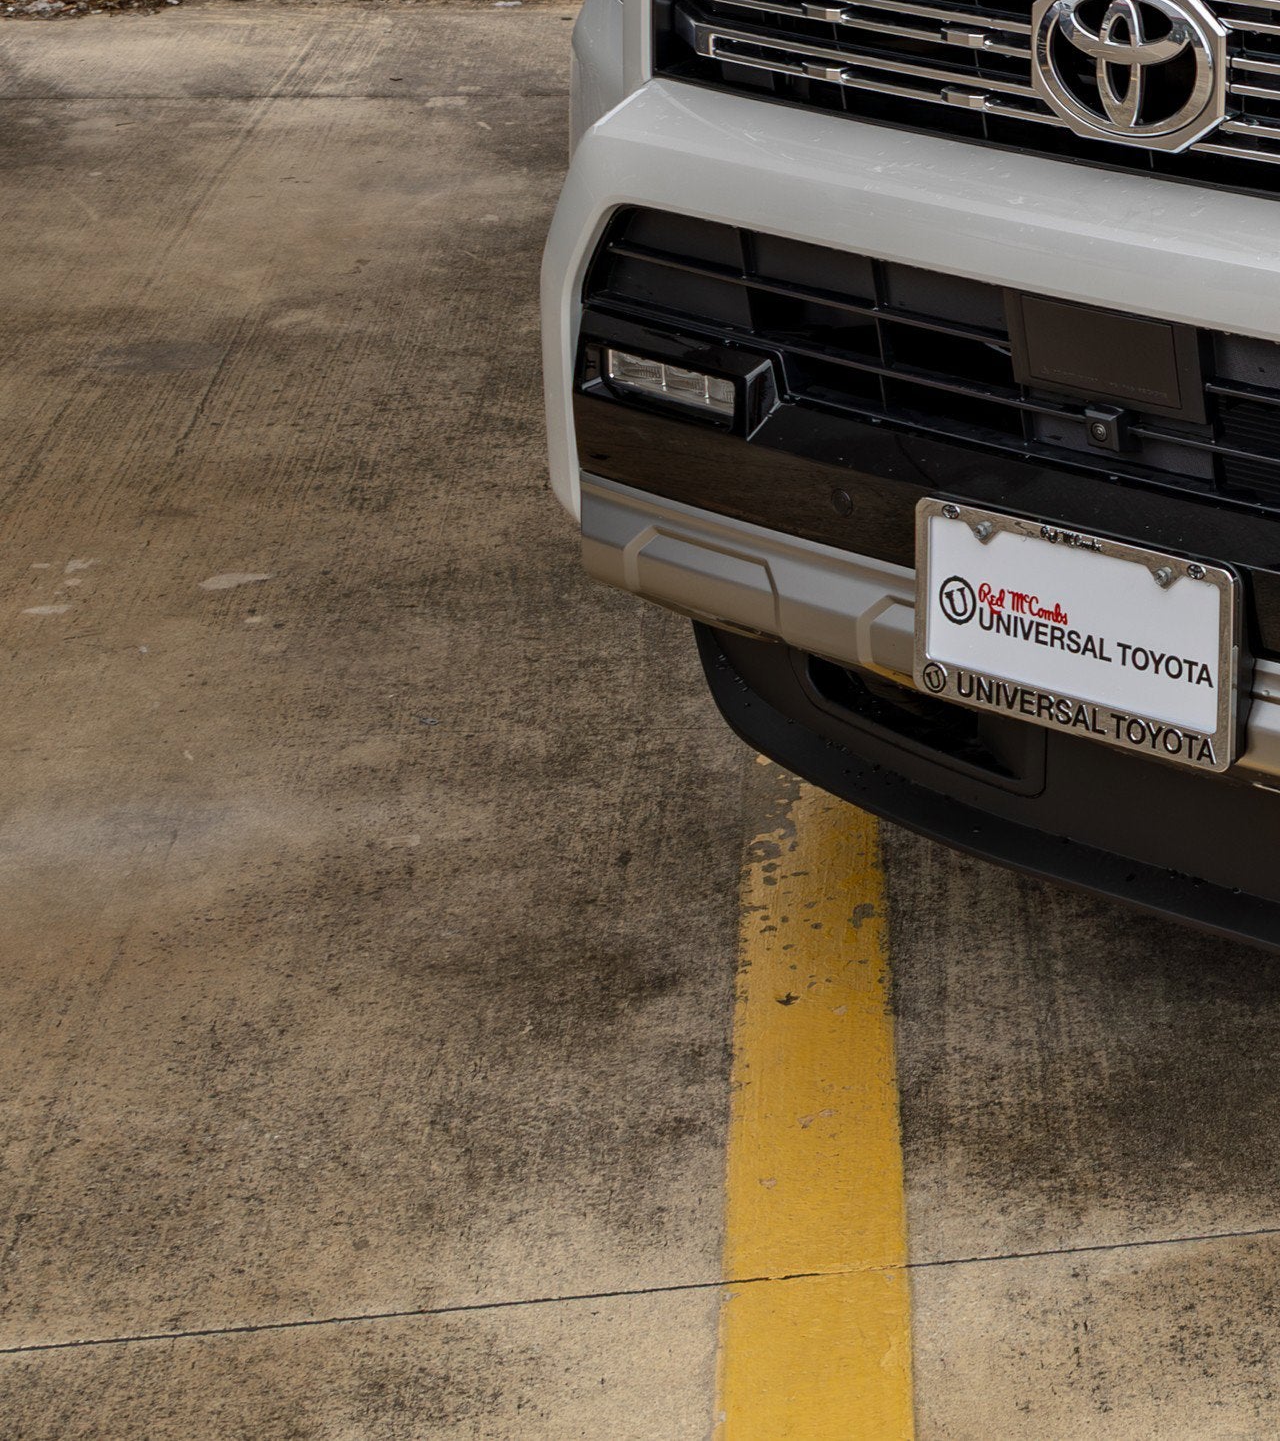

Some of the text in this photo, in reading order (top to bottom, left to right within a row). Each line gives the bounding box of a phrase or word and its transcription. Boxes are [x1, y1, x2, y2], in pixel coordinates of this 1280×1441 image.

[978, 582, 1069, 626] Red McCombs
[978, 607, 1215, 689] UNIVERSAL TOYOTA
[956, 671, 1218, 765] UNIVERSAL TOYOTA
